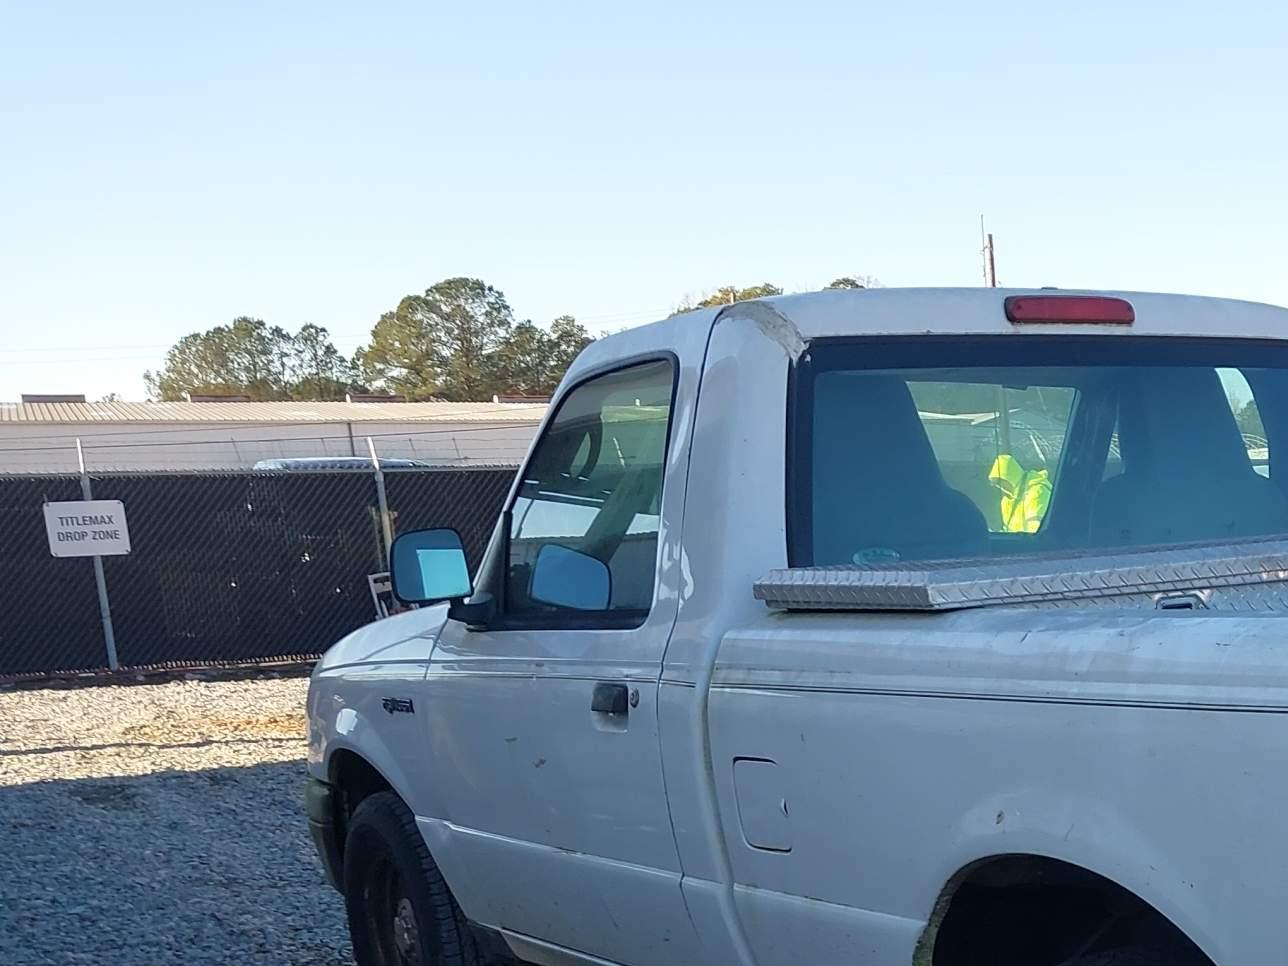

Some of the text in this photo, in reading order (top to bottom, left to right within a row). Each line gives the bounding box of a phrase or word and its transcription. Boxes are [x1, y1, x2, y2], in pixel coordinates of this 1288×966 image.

[57, 515, 114, 527] TITLEMAX
[57, 529, 121, 542] DROP ZONE
